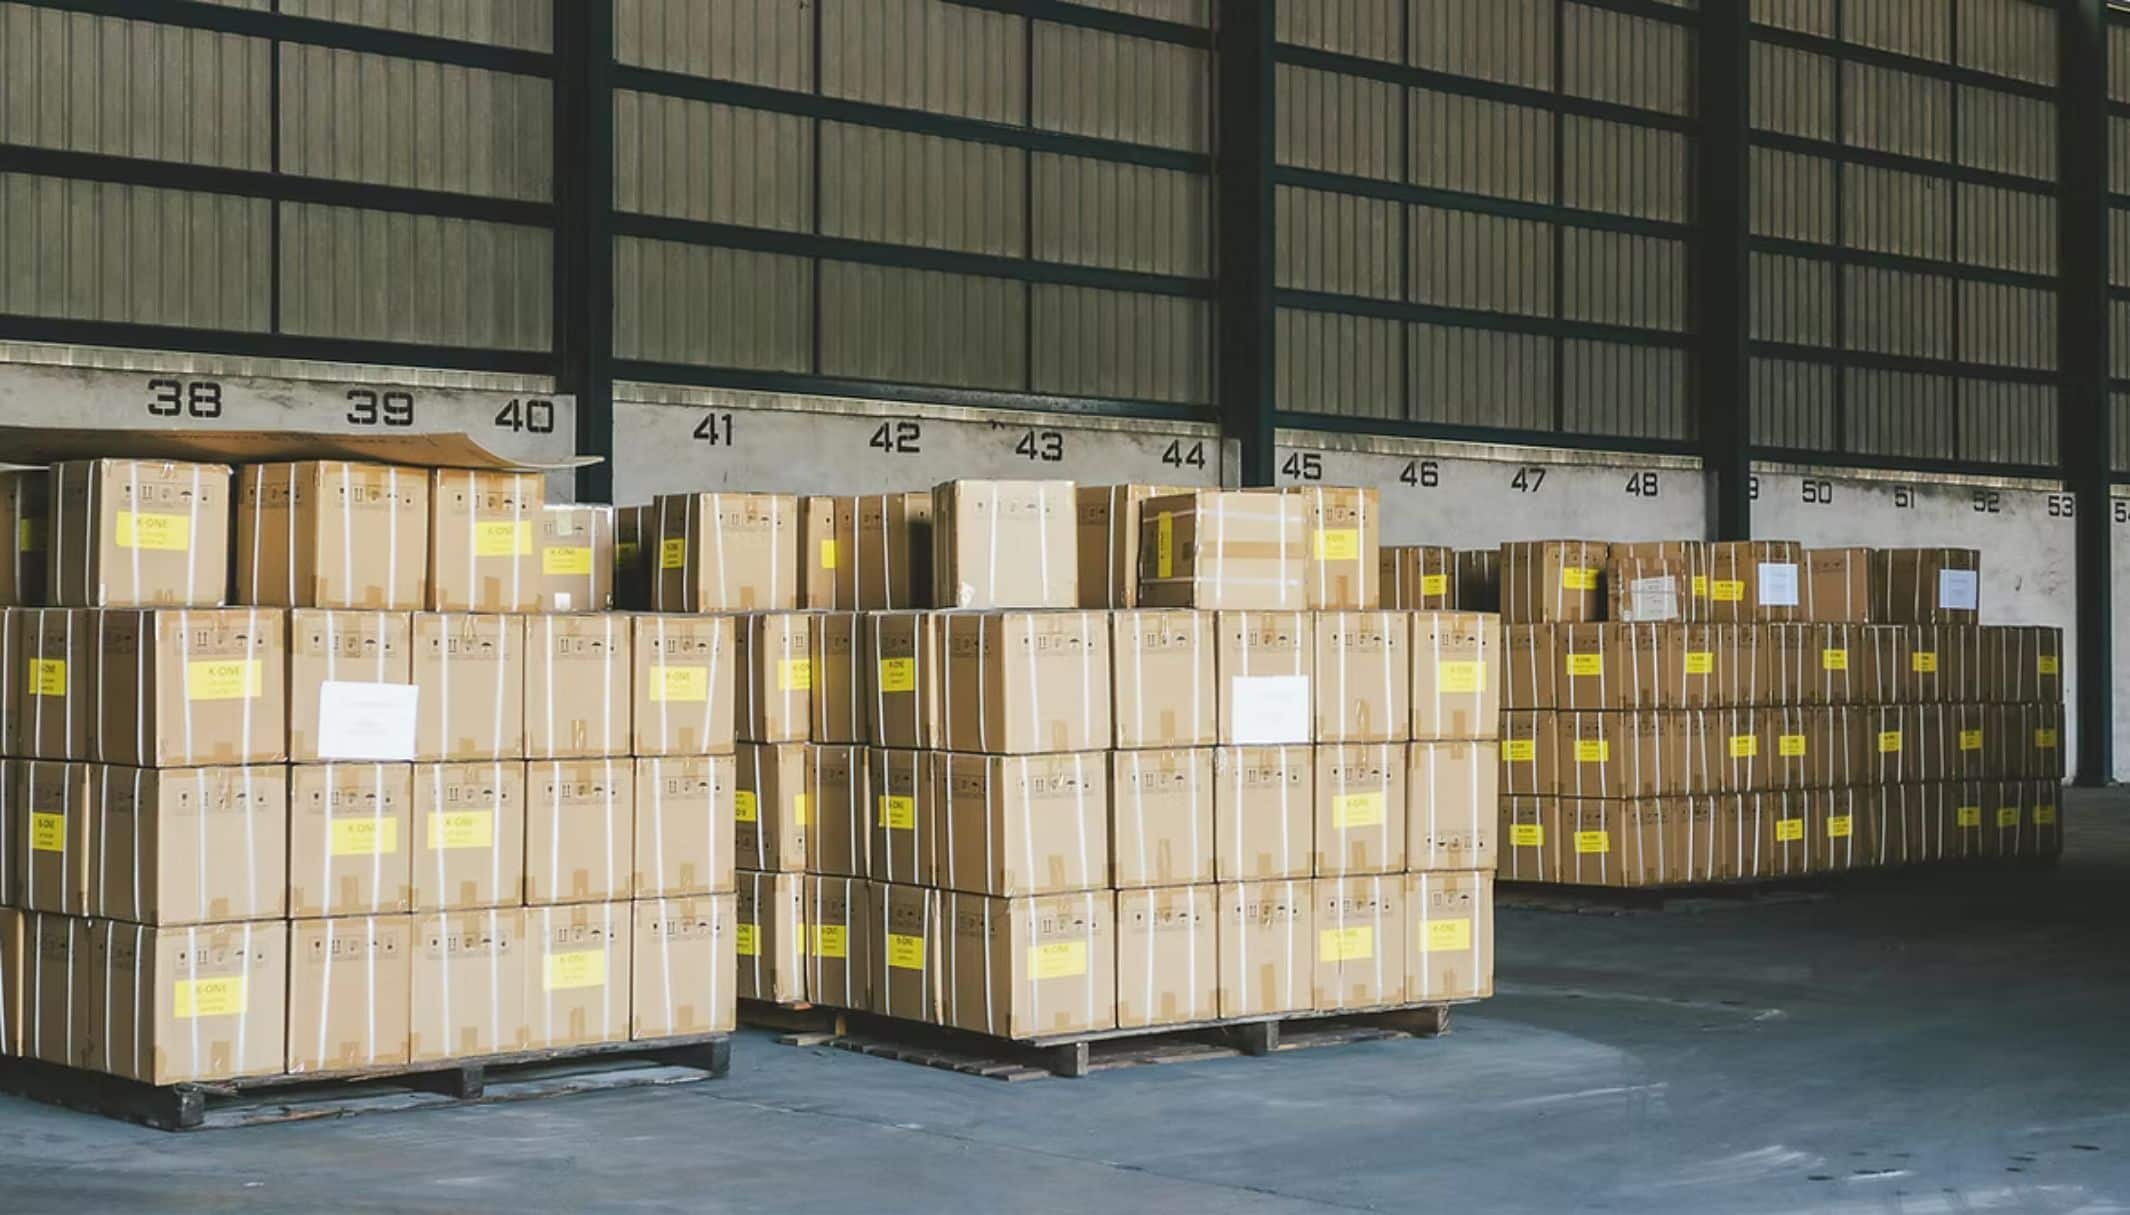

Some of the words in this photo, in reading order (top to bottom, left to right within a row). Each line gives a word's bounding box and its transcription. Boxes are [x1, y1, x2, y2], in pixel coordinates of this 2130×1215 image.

[148, 380, 221, 418] 38
[347, 390, 414, 426] 39
[495, 397, 555, 434] 40
[693, 413, 733, 446] 41
[869, 422, 921, 453] 42
[1015, 432, 1063, 461] 43
[1162, 441, 1206, 470] 44
[1282, 452, 1322, 480] 45
[1400, 461, 1439, 487] 46
[1511, 468, 1547, 493] 47
[1625, 472, 1658, 497] 48
[1802, 480, 1832, 504] 50
[1894, 486, 1914, 508] 51
[1973, 490, 2000, 512] 52
[2048, 495, 2073, 517] 53
[2115, 502, 2130, 523] 5
